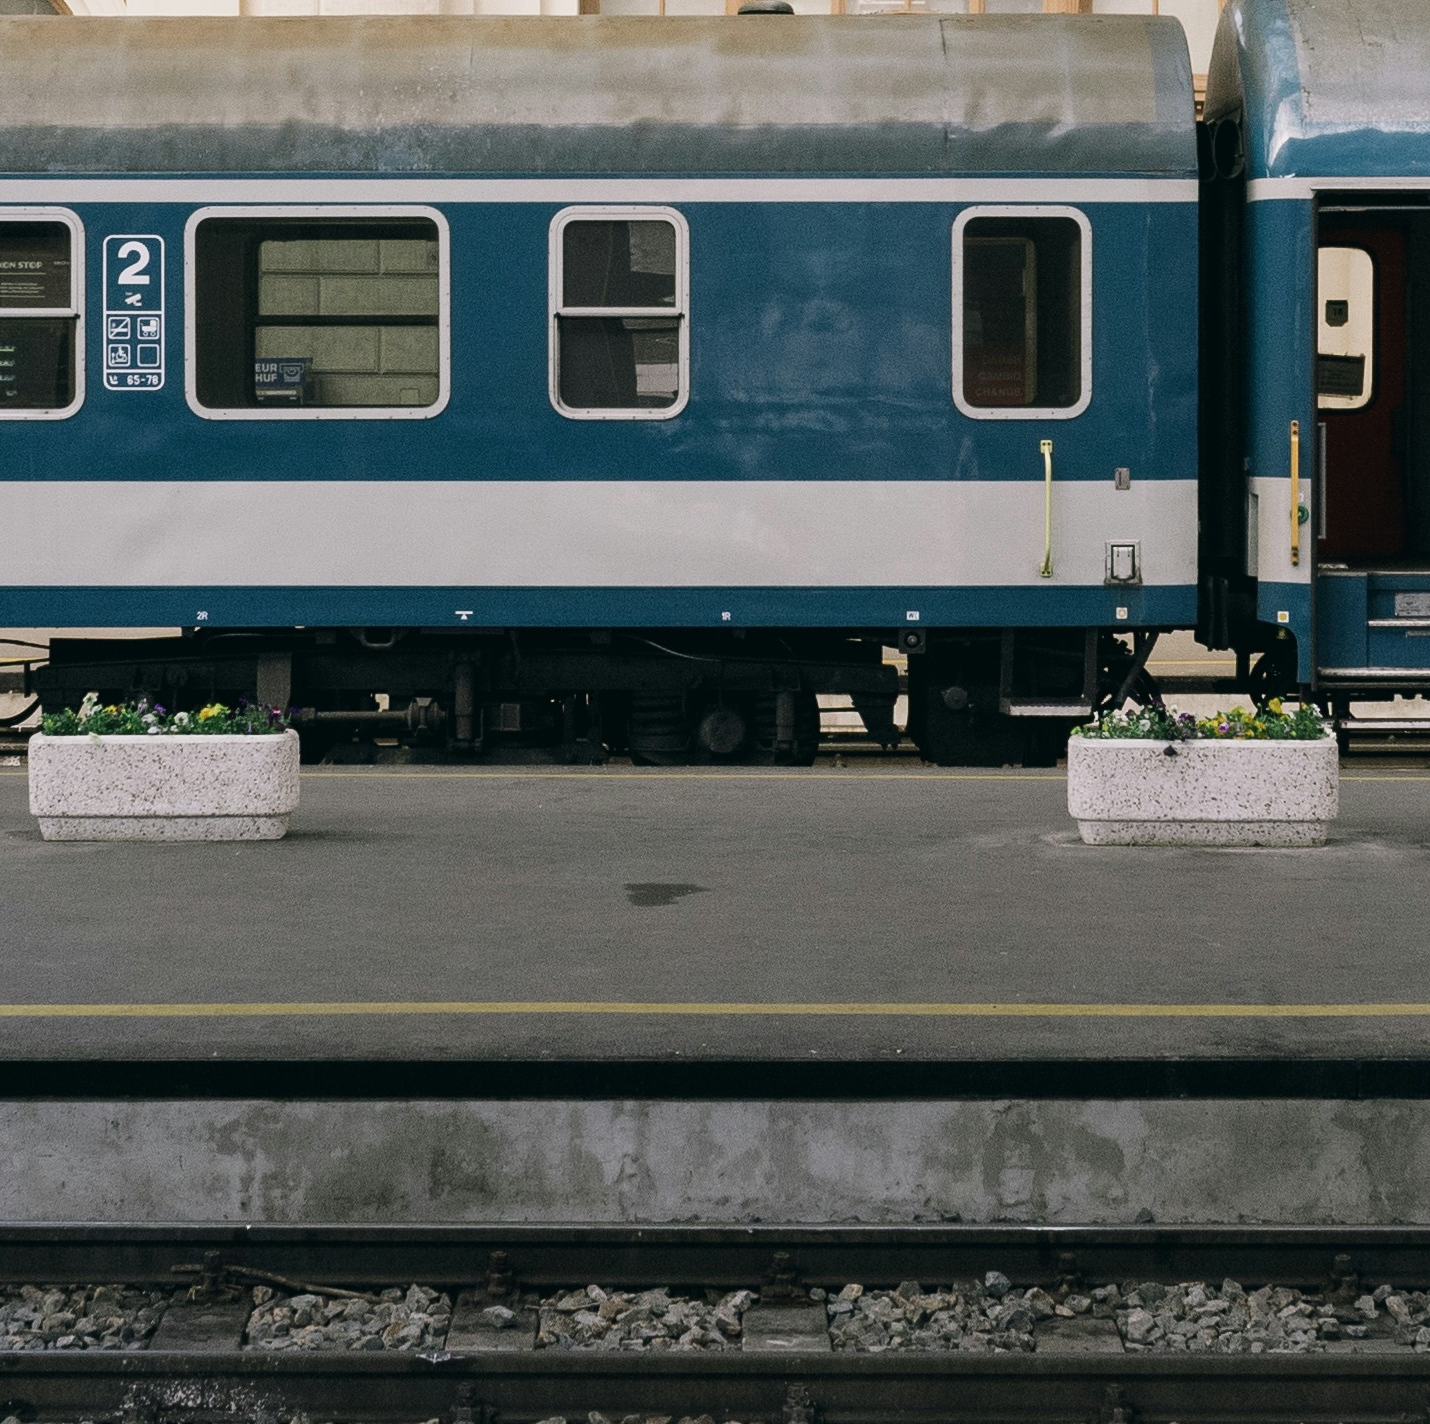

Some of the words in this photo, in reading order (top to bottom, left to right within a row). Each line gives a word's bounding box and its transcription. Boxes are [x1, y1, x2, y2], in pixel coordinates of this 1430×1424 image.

[118, 241, 150, 285] 2
[255, 363, 278, 373] EUR
[126, 375, 159, 385] 65-78
[255, 373, 278, 383] HUF
